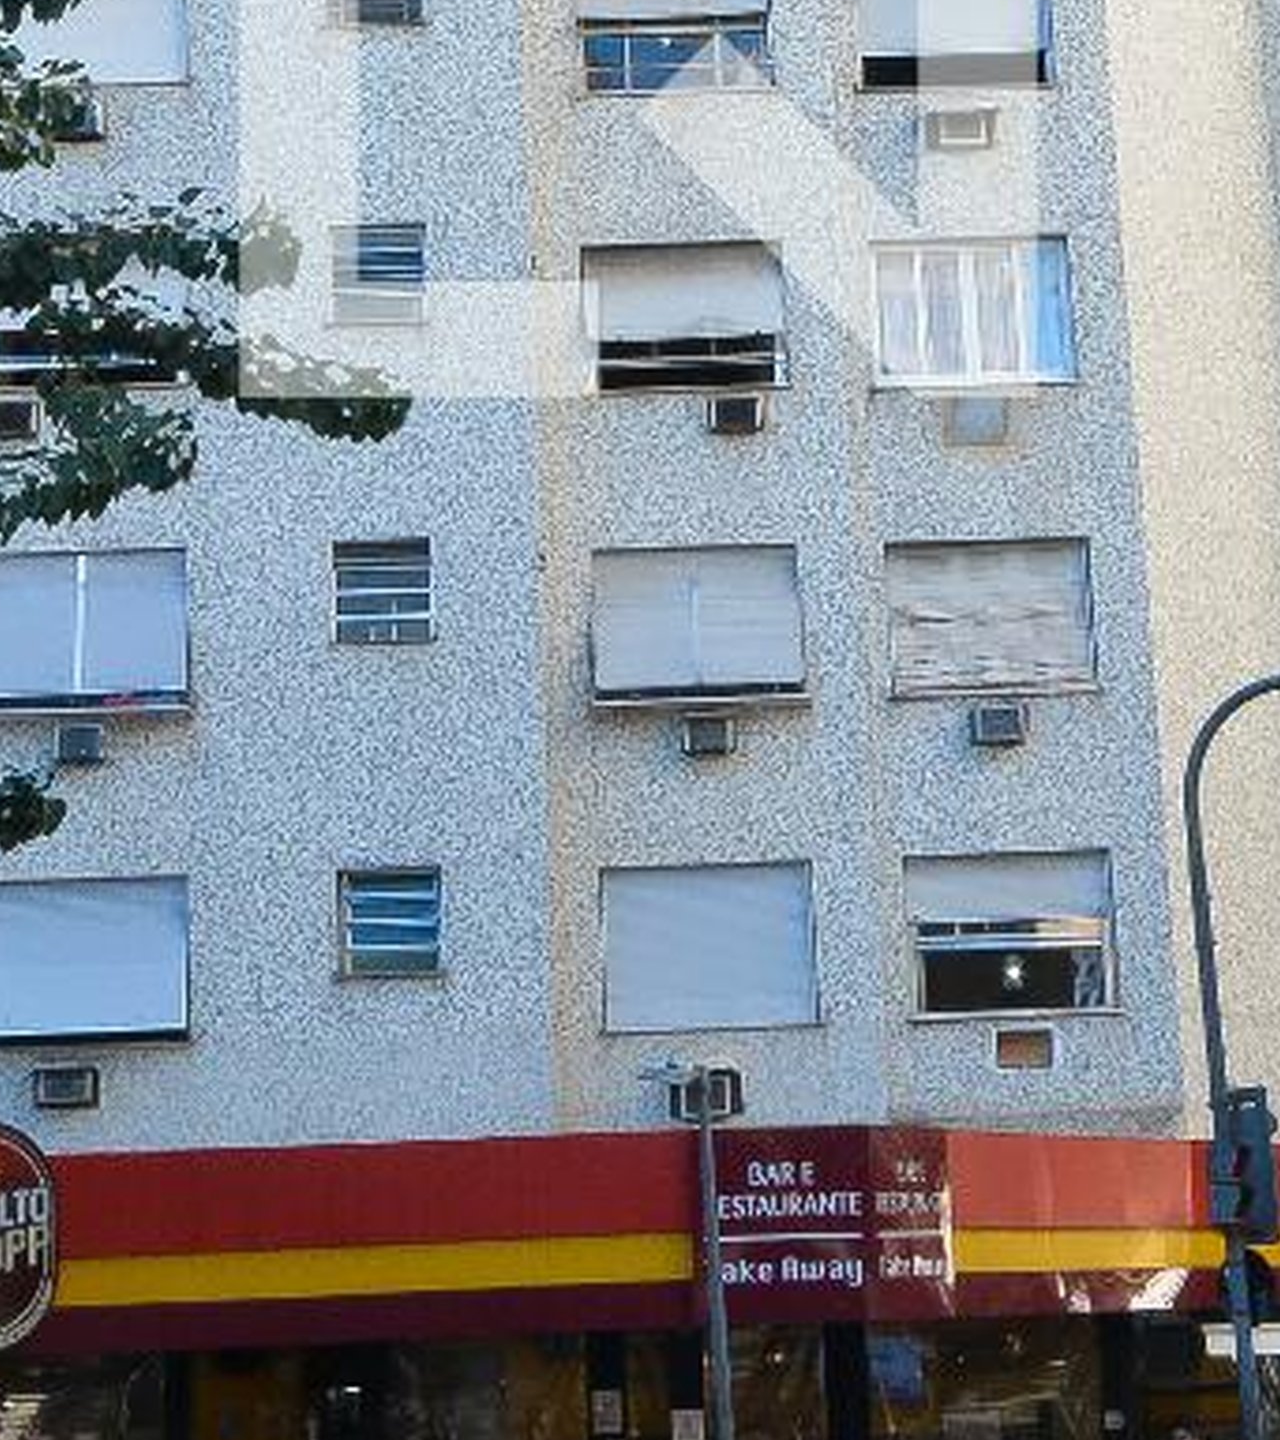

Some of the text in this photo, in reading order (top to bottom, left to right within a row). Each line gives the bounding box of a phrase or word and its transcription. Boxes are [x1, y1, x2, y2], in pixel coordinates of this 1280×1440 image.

[747, 1161, 815, 1186] BAR E
[718, 1191, 864, 1220] ESTAURANTE
[721, 1256, 864, 1287] ake Away
